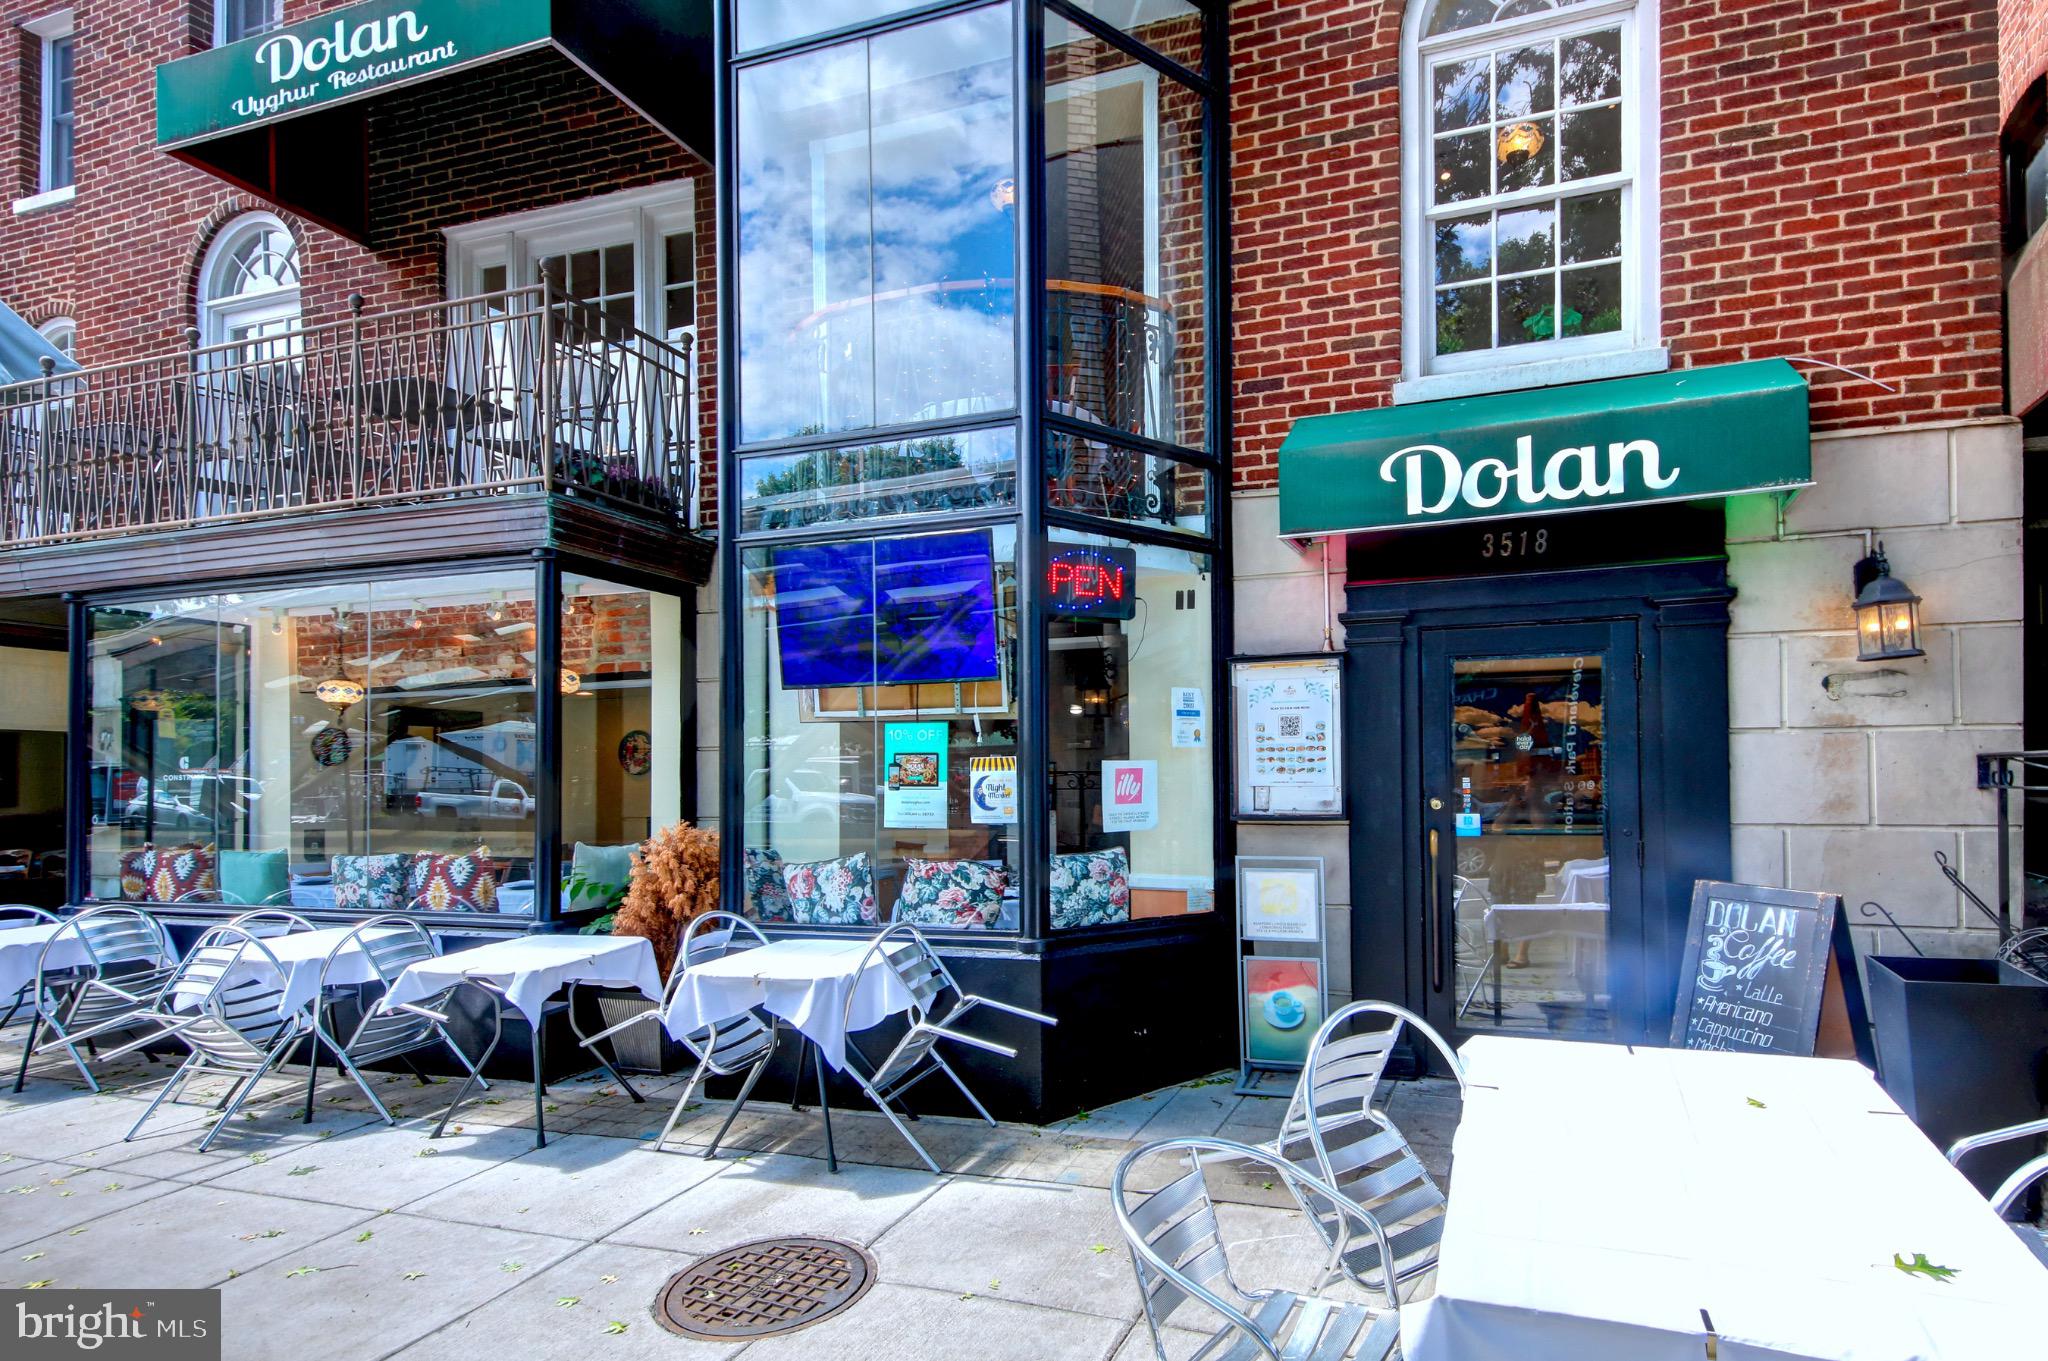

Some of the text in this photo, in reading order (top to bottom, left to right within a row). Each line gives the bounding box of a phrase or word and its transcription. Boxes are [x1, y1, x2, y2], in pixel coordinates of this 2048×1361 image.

[255, 9, 428, 84] Dolan
[232, 40, 457, 117] Uyghur Restaurant
[1379, 434, 1681, 516] Dolan
[1482, 529, 1548, 557] 3518
[1047, 562, 1123, 600] PEN
[888, 728, 943, 742] 10% OFF
[985, 784, 1006, 793] Night
[1116, 772, 1141, 801] illy
[1705, 900, 1800, 937] DOLAN
[1723, 929, 1798, 980] Coffee
[1702, 995, 1774, 1027] Americano
[1696, 1017, 1774, 1048] Cappuccino
